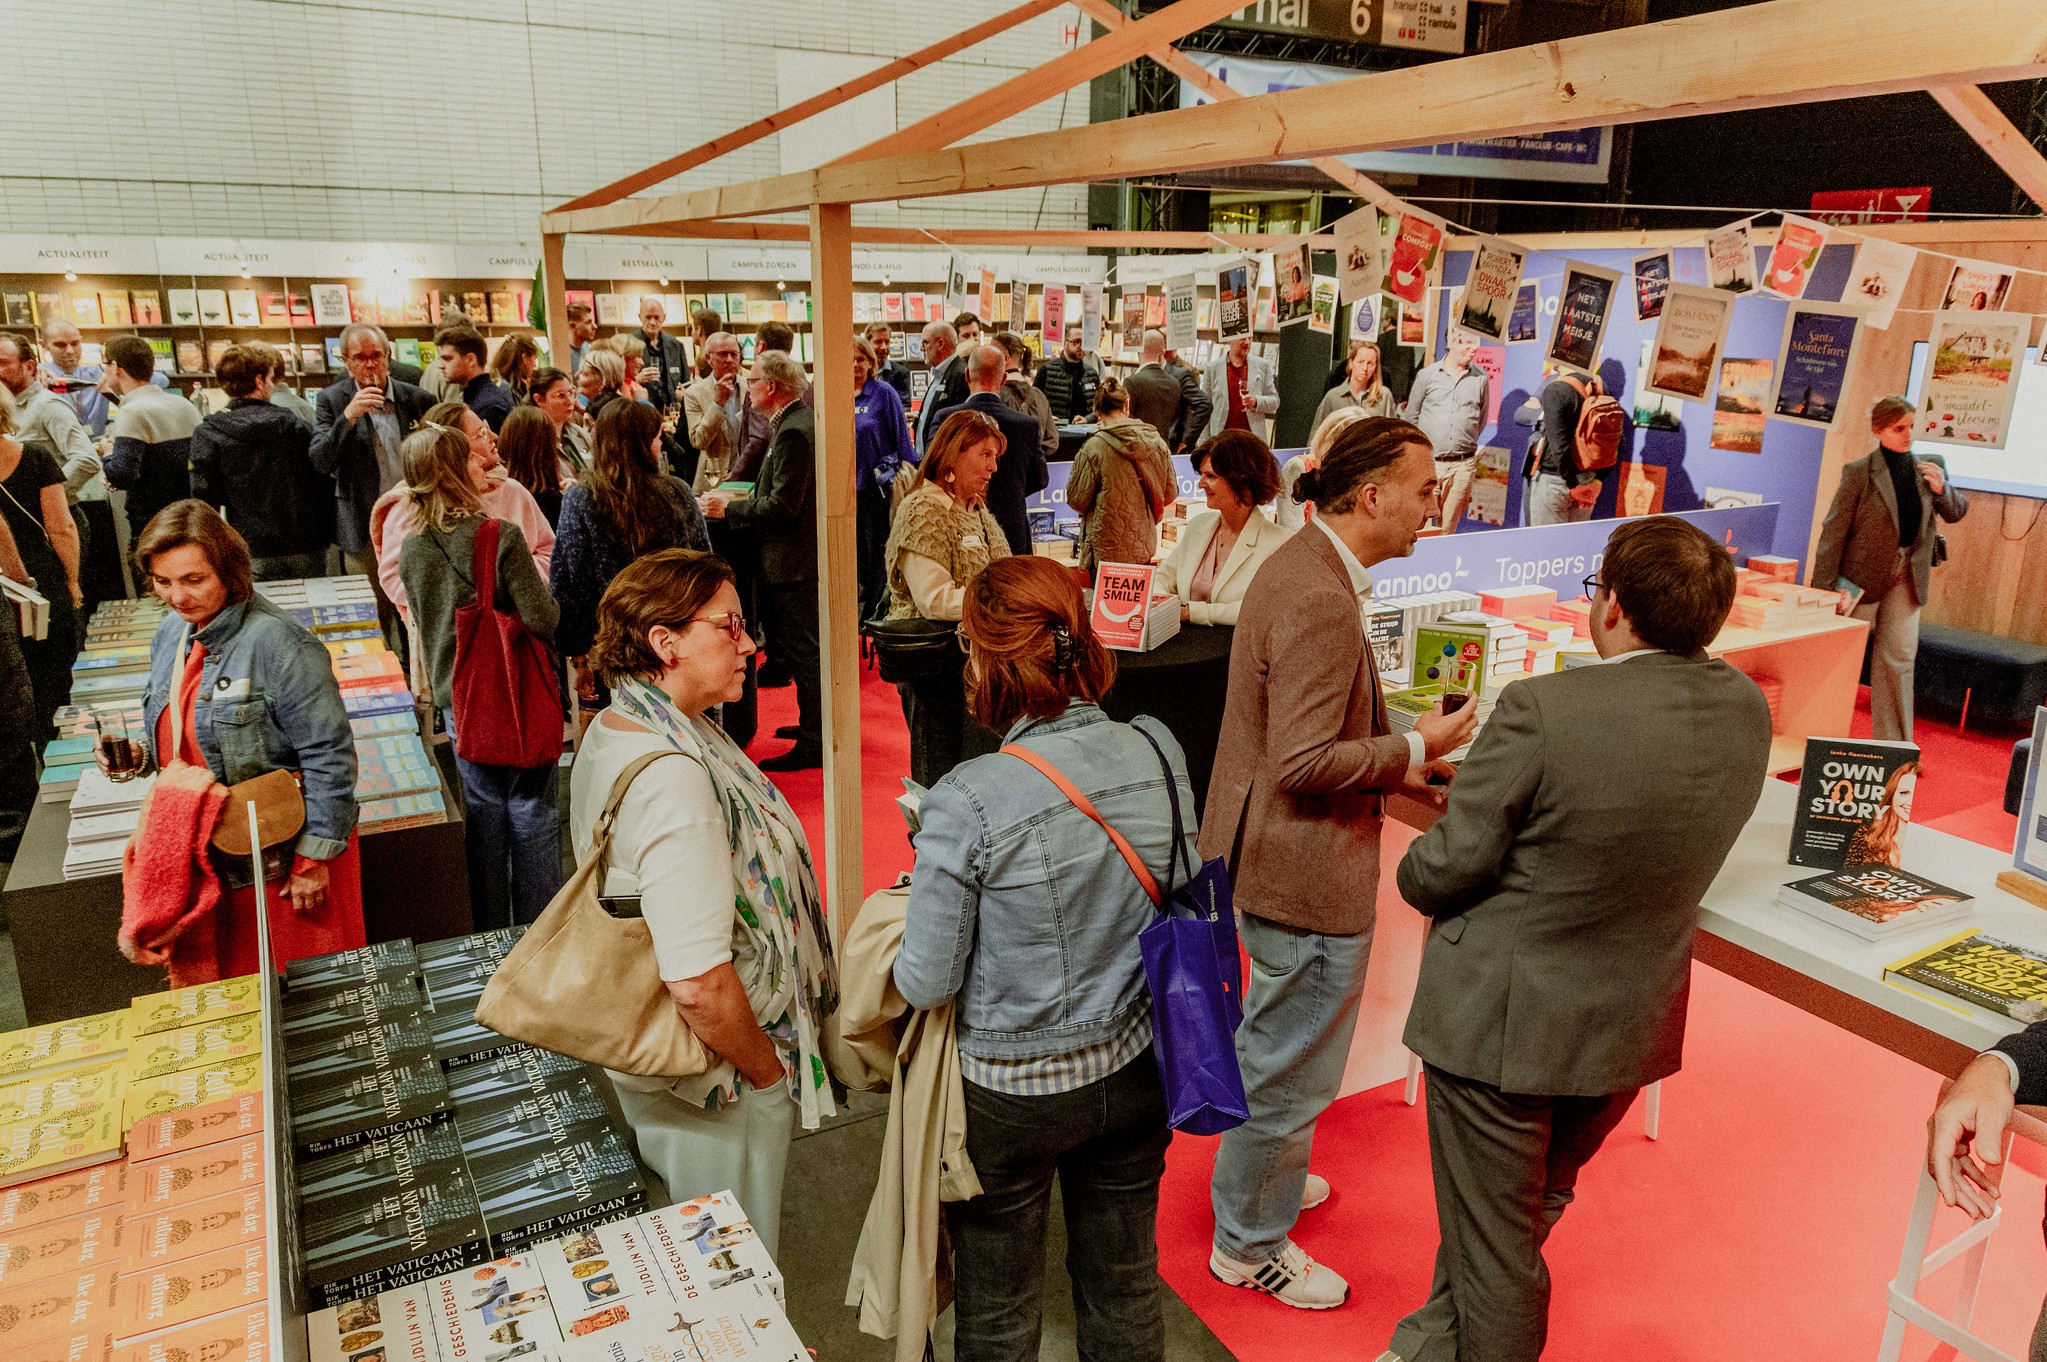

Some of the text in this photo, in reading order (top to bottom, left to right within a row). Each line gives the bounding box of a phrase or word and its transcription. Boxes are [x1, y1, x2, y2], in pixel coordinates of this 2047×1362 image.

[1350, 0, 1371, 35] 6
[1450, 6, 1457, 16] 5
[1066, 25, 1078, 44] H
[1402, 233, 1433, 250] COMFORT
[38, 250, 109, 259] ACTUALITEIT
[204, 253, 270, 262] ACTUAITEIT
[489, 257, 526, 266] CAMPUS
[732, 260, 763, 268] CAMPUS
[1487, 253, 1512, 266] ROBERT
[1482, 260, 1512, 276] BRYNDZA
[1477, 282, 1507, 299] SPOOR
[1479, 272, 1508, 290] DWAAL
[1171, 297, 1193, 313] ALLES
[1578, 292, 1596, 305] HET
[1563, 306, 1601, 325] LAATSTE
[1563, 324, 1593, 341] MEISJE
[1809, 331, 1835, 345] Santa
[1793, 341, 1848, 358] Montefiore
[1939, 378, 2000, 388] MANUELA INUSA
[1496, 556, 1586, 586] Toppers
[1103, 576, 1145, 592] TEAM
[1103, 590, 1141, 602] SMILE
[1823, 762, 1885, 782] OWN
[1820, 779, 1887, 804] YOUR
[1810, 797, 1890, 820] STORY
[1837, 875, 1914, 904] STORY
[1871, 870, 1931, 894] OWN
[470, 935, 485, 949] HET
[344, 950, 359, 964] HET
[359, 946, 378, 984] VATICAAN
[344, 989, 359, 1005] HET
[359, 985, 380, 1025] VATICAAN
[352, 1030, 368, 1046] HET
[368, 1025, 390, 1069] VATICAAN
[470, 1049, 494, 1062] HET
[504, 1053, 521, 1070] HET
[519, 1049, 546, 1094] VATICAAN
[361, 1075, 379, 1093] HET
[378, 1070, 402, 1119] VATICAAN
[238, 1096, 256, 1130] Elke dag
[521, 1099, 541, 1119] HET
[537, 1094, 568, 1144] VATICAAN
[157, 1117, 176, 1149] zelfzorg
[334, 1115, 433, 1148] HET VATICAAN
[310, 1143, 333, 1153] TORFS
[372, 1138, 390, 1160] HET
[240, 1142, 258, 1181] Elke dag
[389, 1133, 415, 1187] VATICAAN
[541, 1152, 563, 1174] HET
[154, 1165, 174, 1203] zelfzorg
[558, 1146, 593, 1202] VATICAAN
[85, 1186, 104, 1205] dag
[242, 1191, 261, 1235] Elke dag
[383, 1195, 402, 1219] HET
[526, 1197, 626, 1236] HET VATICAAN
[401, 1189, 427, 1252] VATICAAN
[79, 1217, 101, 1262] Elke dag
[151, 1216, 173, 1258] zelfzorg
[502, 1232, 525, 1243] TORFS
[352, 1245, 463, 1287] HET VATICAAN
[621, 1231, 657, 1296] TIJDLIJN VAN
[650, 1214, 699, 1299] DE GESCHIEDENIS
[244, 1246, 264, 1296] Elke dag
[354, 1258, 465, 1300] HET VATICAAN
[147, 1273, 170, 1320] zelfzorg
[324, 1282, 337, 1290] RIK
[324, 1283, 349, 1295] TORFS
[70, 1273, 96, 1323] Elke dag
[326, 1295, 339, 1303] RIK
[404, 1299, 418, 1320] VAN
[440, 1279, 467, 1357] GESCHIEDENIS
[247, 1312, 266, 1338] Elke
[706, 1329, 728, 1356] voor
[716, 1315, 748, 1359] werpen
